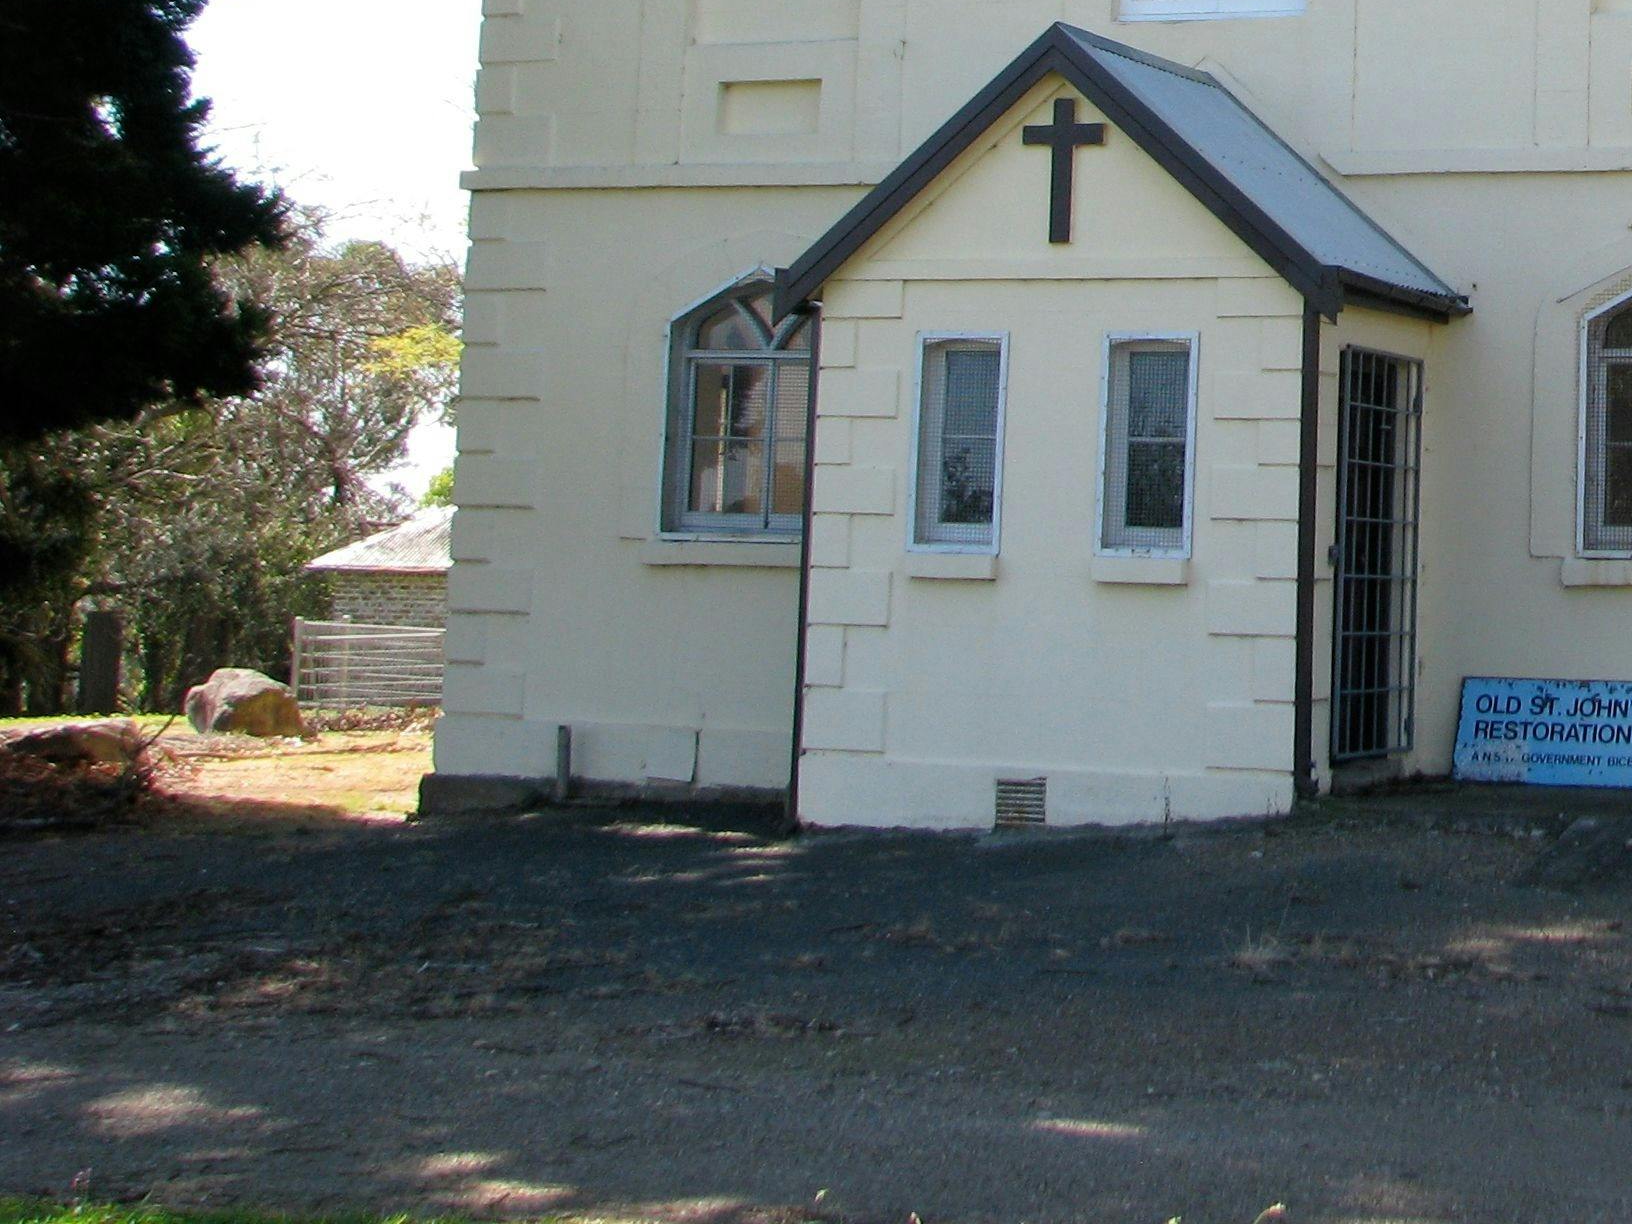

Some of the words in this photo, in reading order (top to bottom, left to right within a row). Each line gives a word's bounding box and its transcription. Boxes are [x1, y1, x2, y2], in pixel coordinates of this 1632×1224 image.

[1475, 694, 1521, 715] OLD
[1474, 720, 1632, 744] RESTORATION
[1521, 753, 1601, 766] GOVERNMENT
